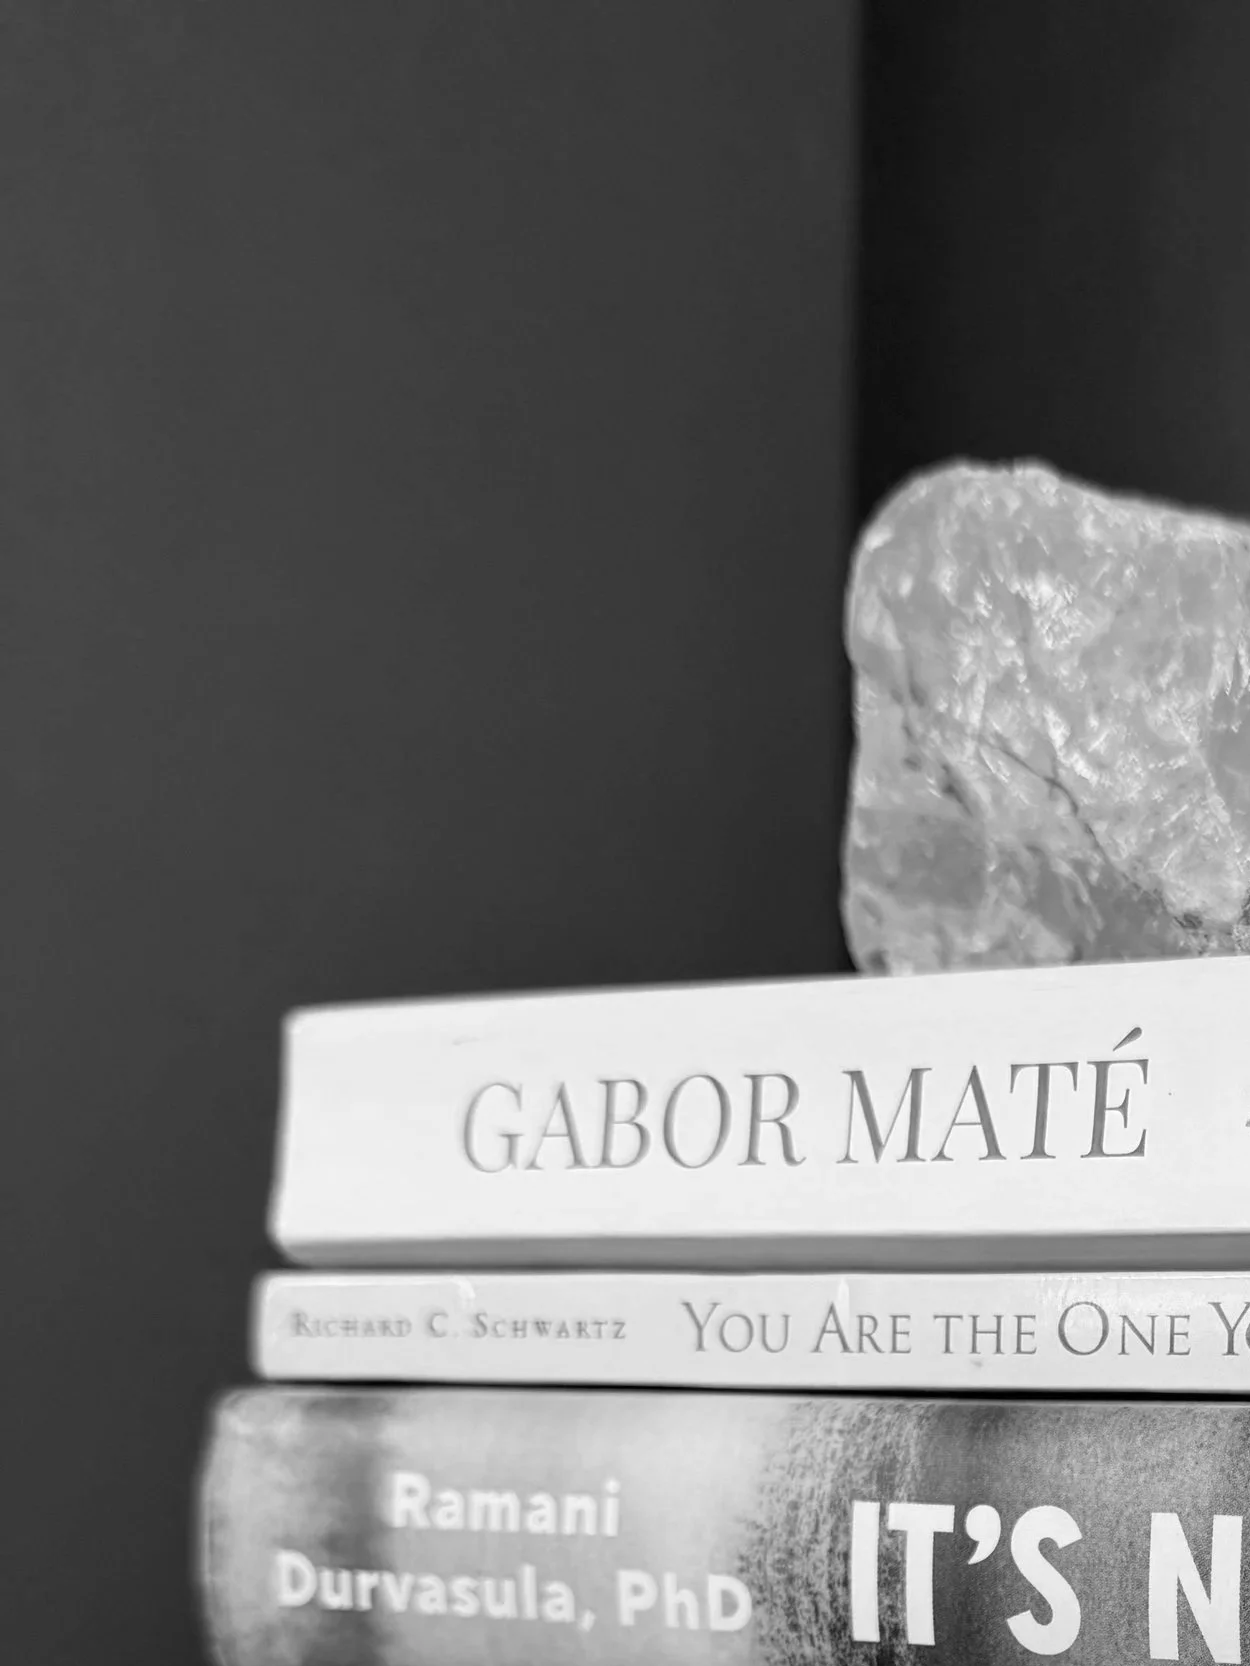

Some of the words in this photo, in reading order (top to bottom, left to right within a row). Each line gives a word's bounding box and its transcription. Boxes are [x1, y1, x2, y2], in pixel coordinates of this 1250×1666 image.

[463, 1072, 806, 1173] GABOR
[836, 1026, 1149, 1164] MATÉ
[933, 1313, 1038, 1356] THE
[387, 1472, 621, 1538] Ramani
[275, 1550, 596, 1632] Durvasula,
[619, 1570, 754, 1633] PhD
